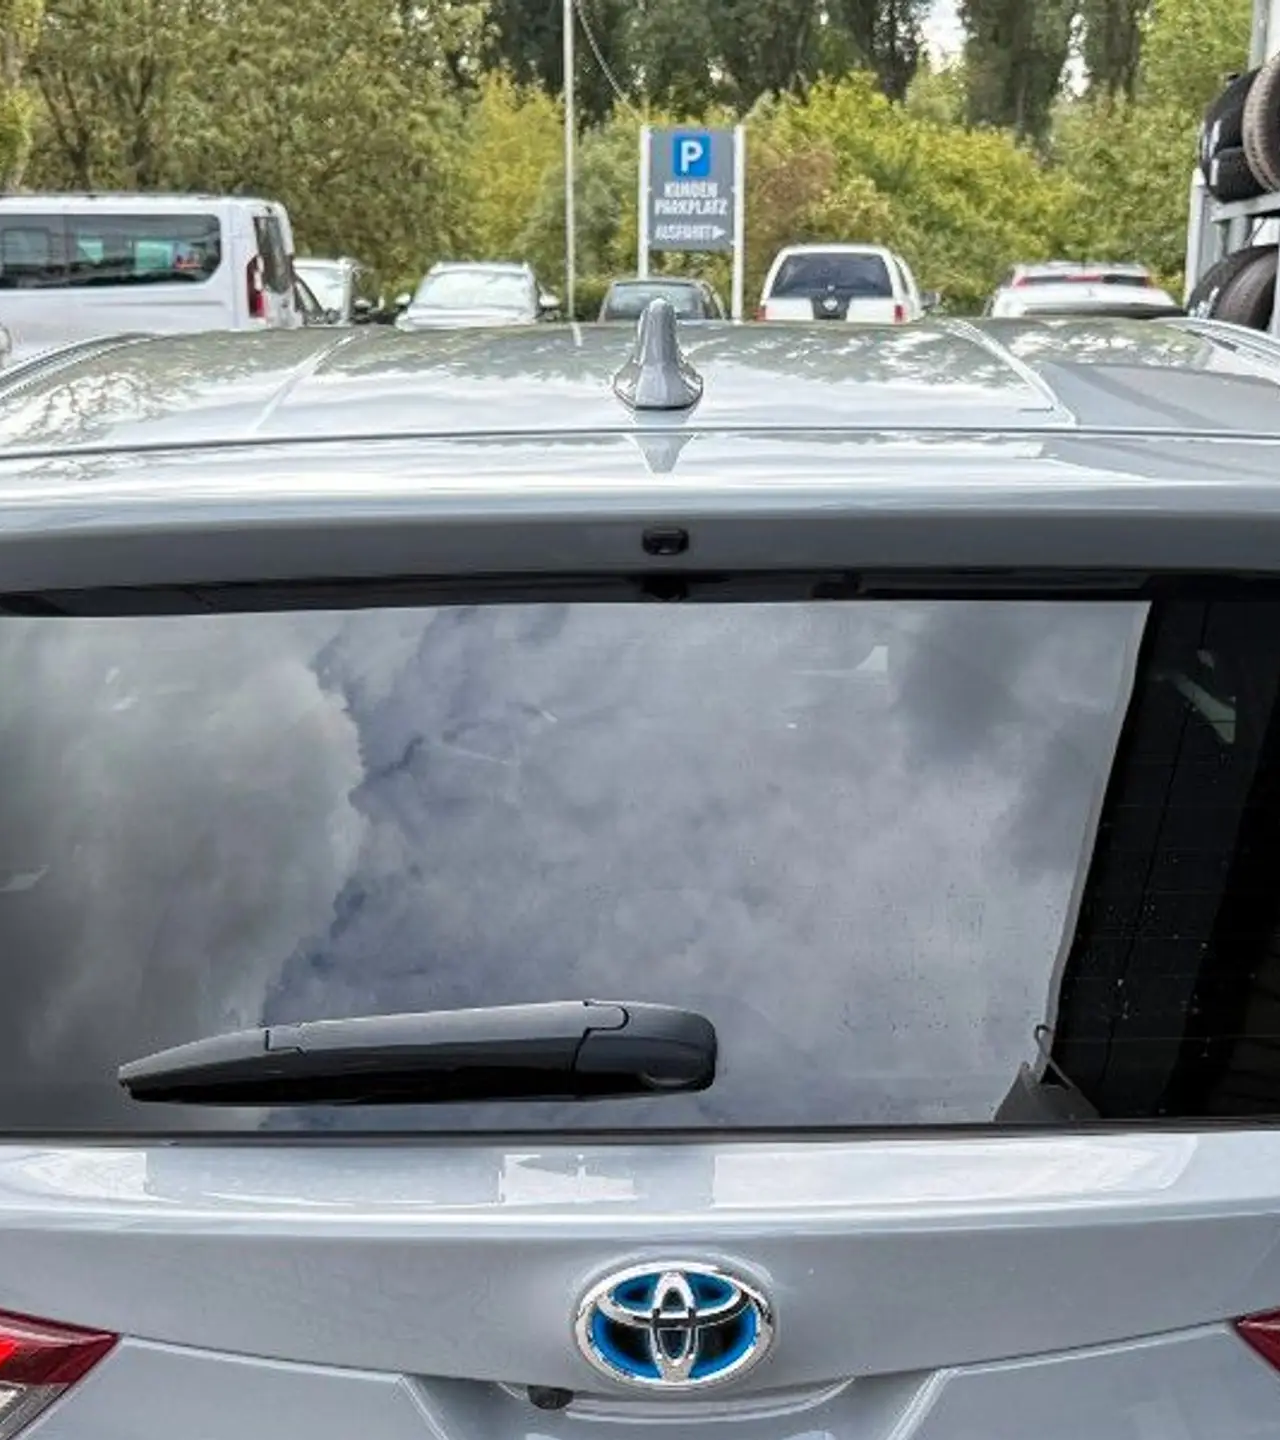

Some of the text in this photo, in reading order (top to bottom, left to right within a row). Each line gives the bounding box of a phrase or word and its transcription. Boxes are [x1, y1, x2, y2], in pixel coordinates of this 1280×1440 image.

[681, 140, 704, 173] P
[663, 181, 719, 198] KUNDEN
[654, 198, 728, 216] PARKPLATZ
